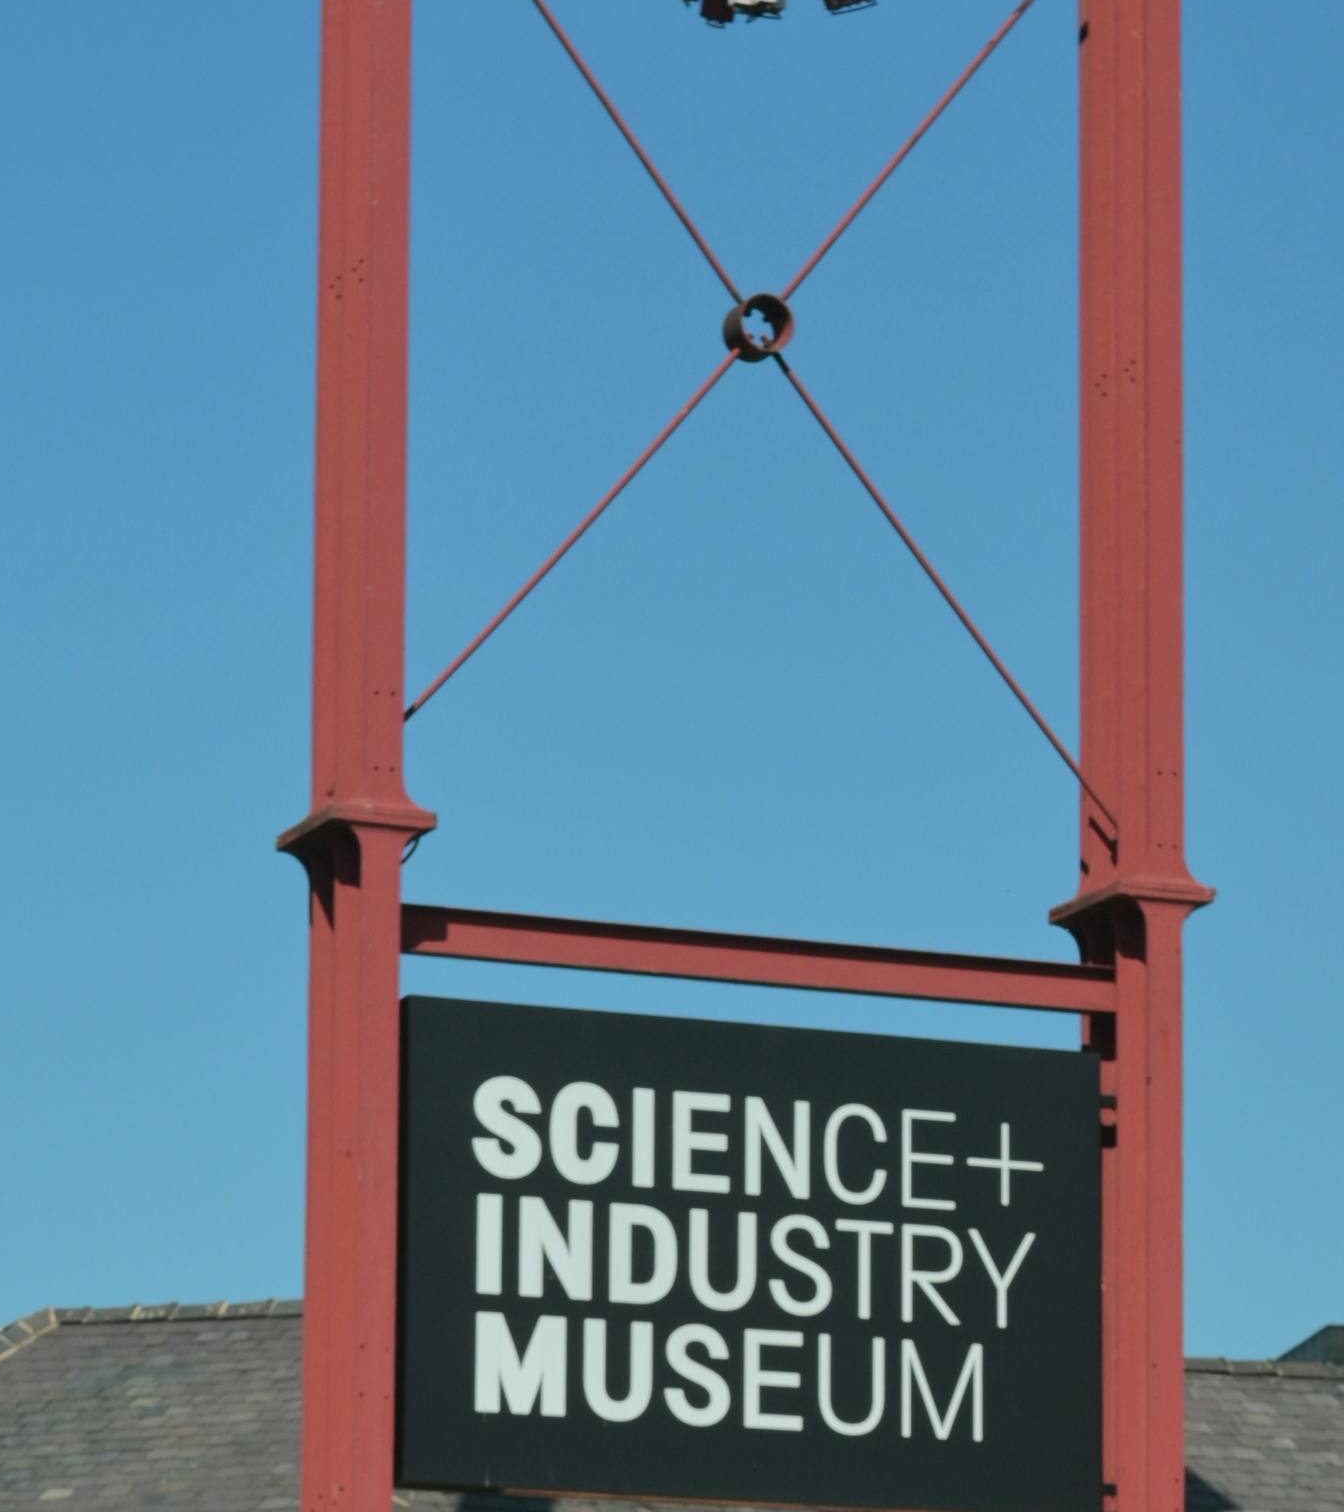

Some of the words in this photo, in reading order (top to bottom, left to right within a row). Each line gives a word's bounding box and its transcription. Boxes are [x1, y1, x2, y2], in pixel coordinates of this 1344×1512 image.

[472, 1075, 1044, 1210] SCIENCE+
[475, 1192, 1035, 1329] INDUSTRY
[474, 1311, 983, 1442] MUSEUM
